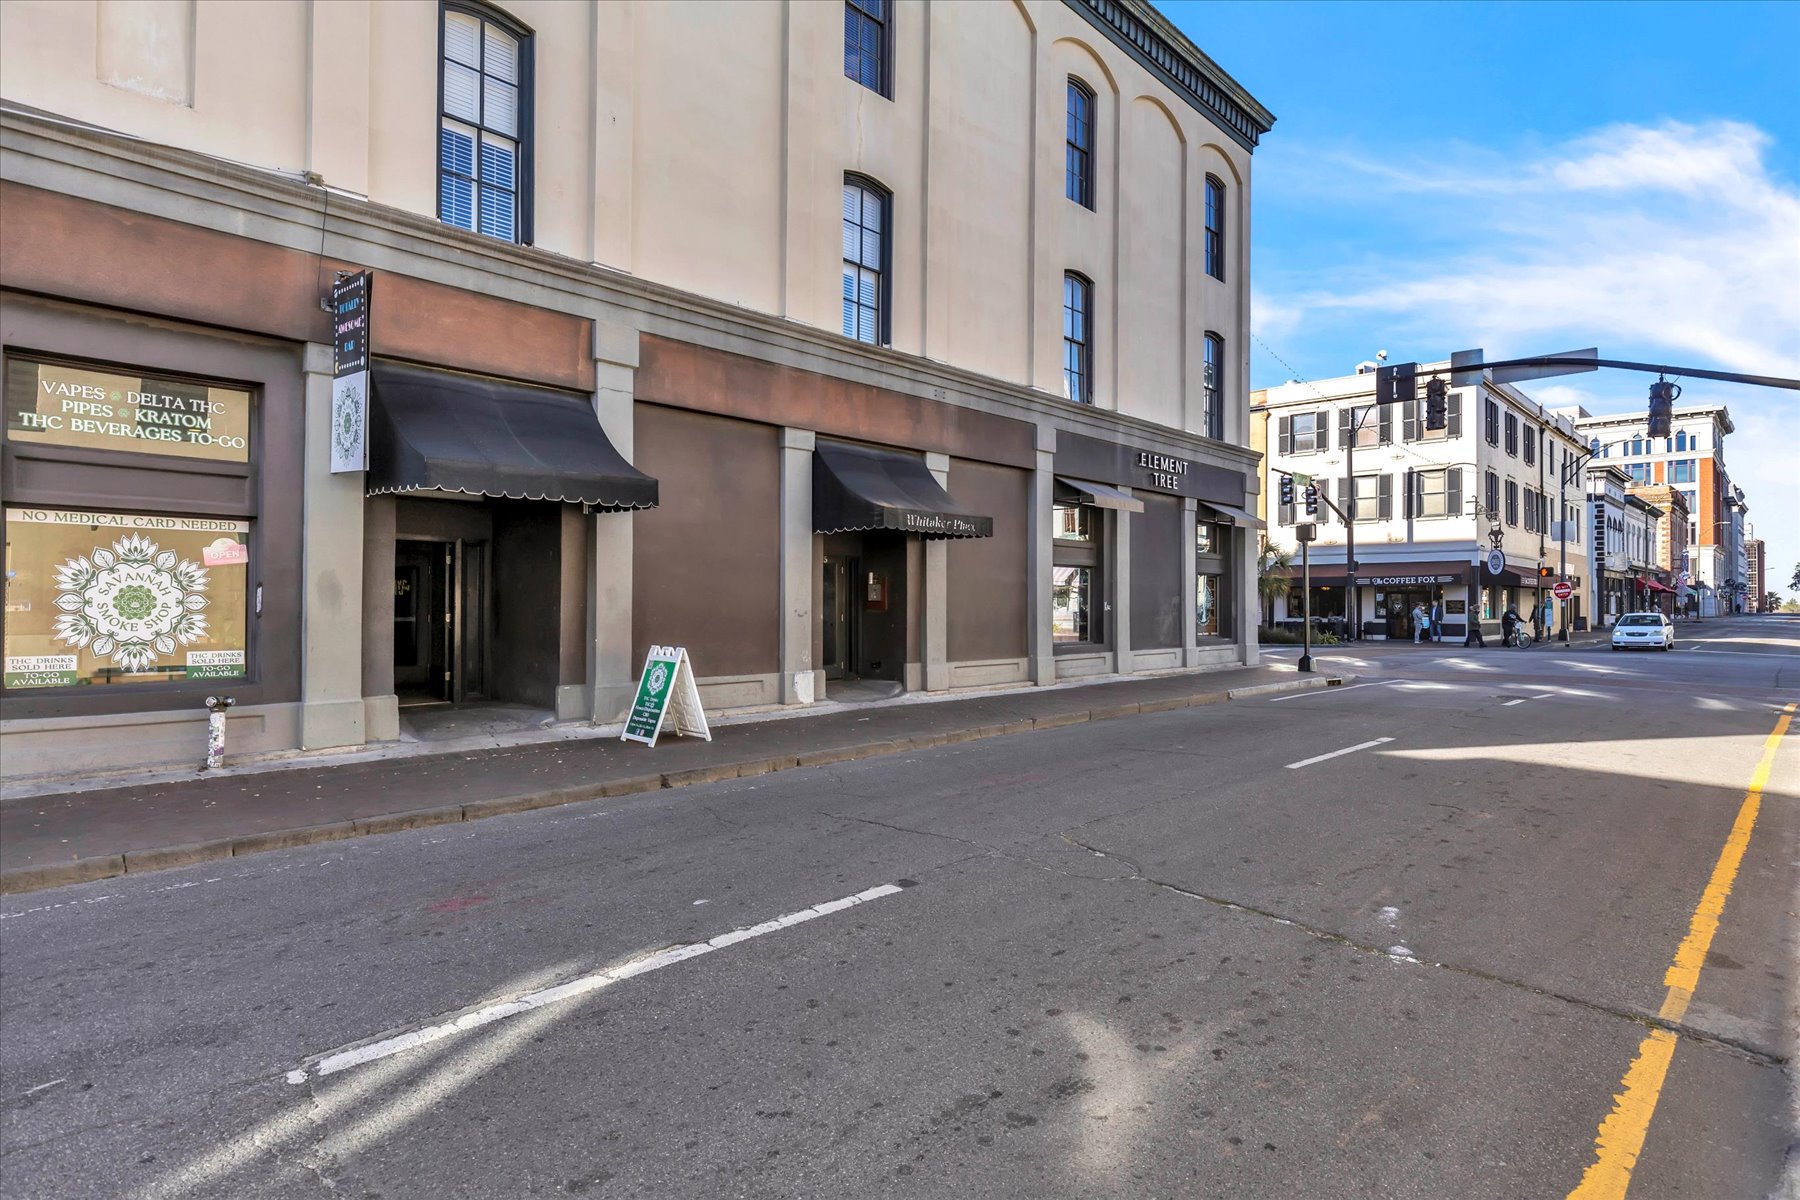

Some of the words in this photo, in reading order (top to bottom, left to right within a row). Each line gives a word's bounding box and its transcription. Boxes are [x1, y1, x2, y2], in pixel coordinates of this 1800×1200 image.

[338, 316, 362, 334] AWESOME
[42, 381, 105, 400] VAPES
[127, 391, 185, 410] DELTA
[190, 399, 225, 414] THC
[62, 400, 113, 417] PIPES
[135, 409, 212, 429] KRATOM
[18, 411, 63, 429] THC
[71, 418, 182, 442] BEVERAGES
[187, 431, 245, 448] TO-GO
[1141, 452, 1188, 475] ELEMENT
[1153, 472, 1178, 490] TREE
[22, 510, 47, 521] NO
[54, 512, 128, 526] MEDICAL
[133, 517, 176, 528] CARD
[181, 519, 237, 531] NEEDED
[906, 513, 951, 529] Whitaker
[210, 550, 240, 559] OPEN
[98, 572, 172, 596] SAVANNAH
[97, 602, 139, 632] SMOKE
[144, 602, 172, 630] SHOP
[12, 677, 70, 686] AVAILABLE
[24, 671, 60, 679] TO-GO
[192, 670, 239, 678] AVAILABLE
